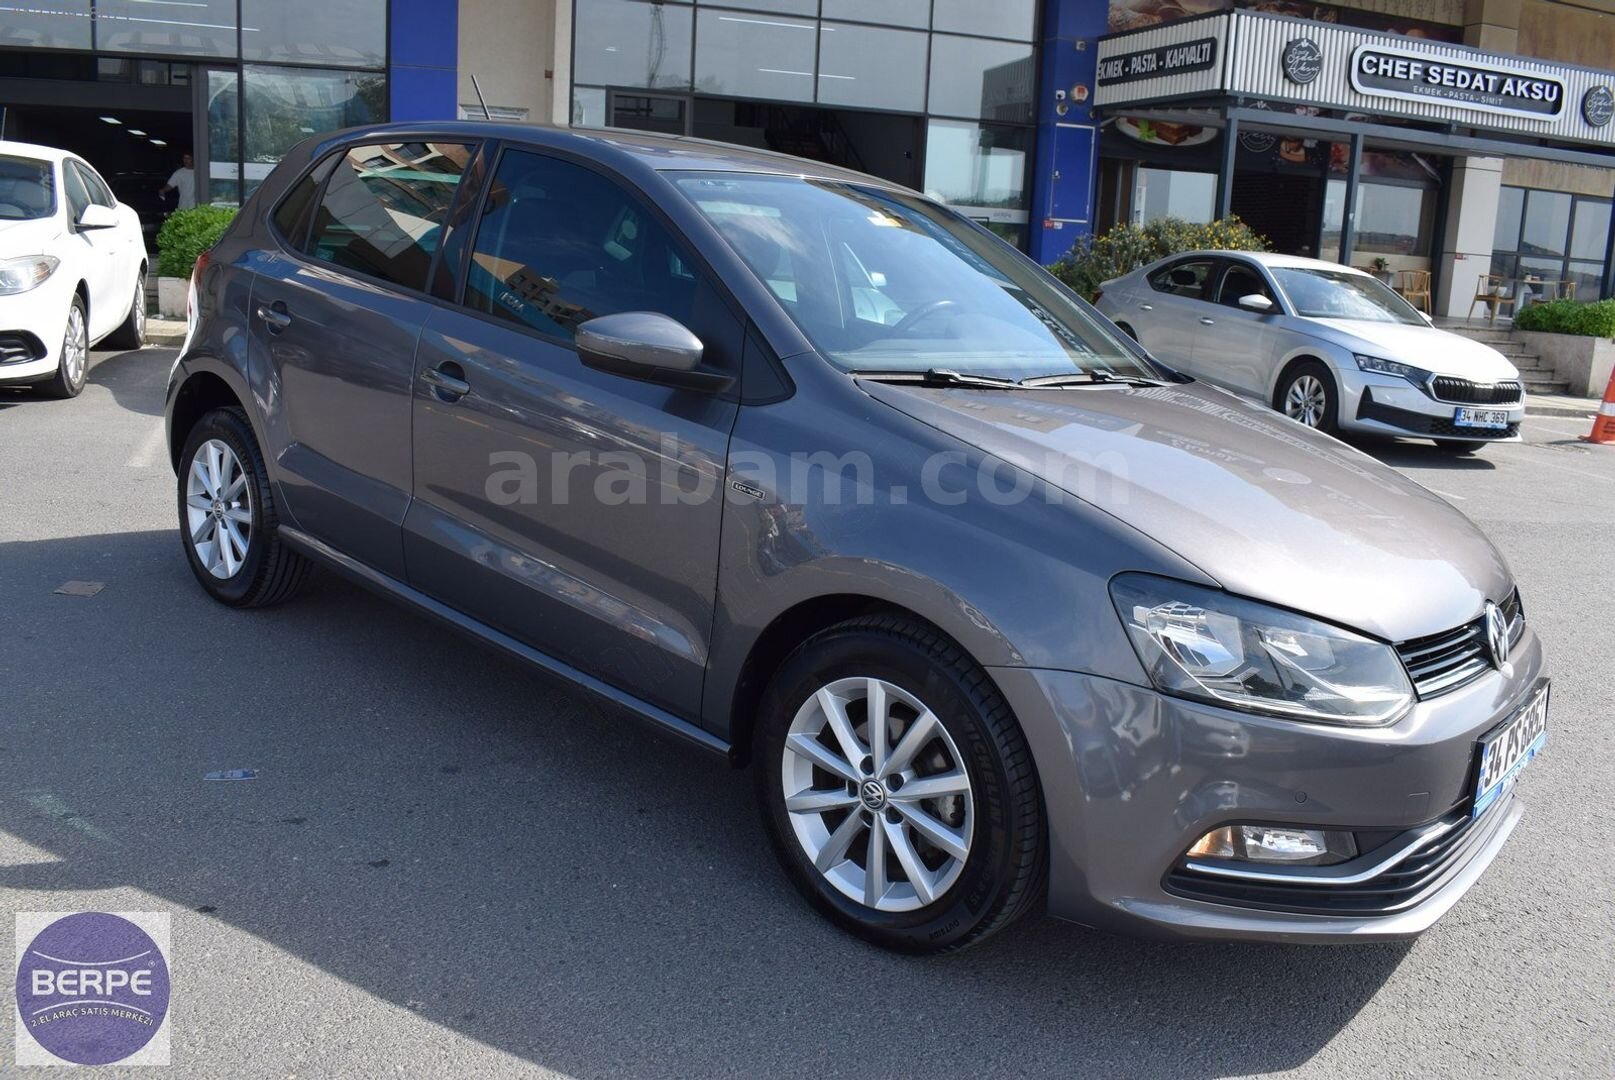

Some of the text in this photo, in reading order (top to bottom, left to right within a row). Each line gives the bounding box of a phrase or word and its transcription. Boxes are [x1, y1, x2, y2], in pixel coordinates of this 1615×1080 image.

[1131, 53, 1157, 75] PASTA
[1165, 42, 1212, 69] KAHVALTI
[1361, 55, 1558, 102] CHEF SEDAT AKSU
[1412, 85, 1442, 96] EKMEK
[1448, 90, 1474, 101] PASTA
[1461, 410, 1505, 424] 34 NHC 369
[1485, 736, 1503, 789] 34
[1504, 718, 1522, 772] PS
